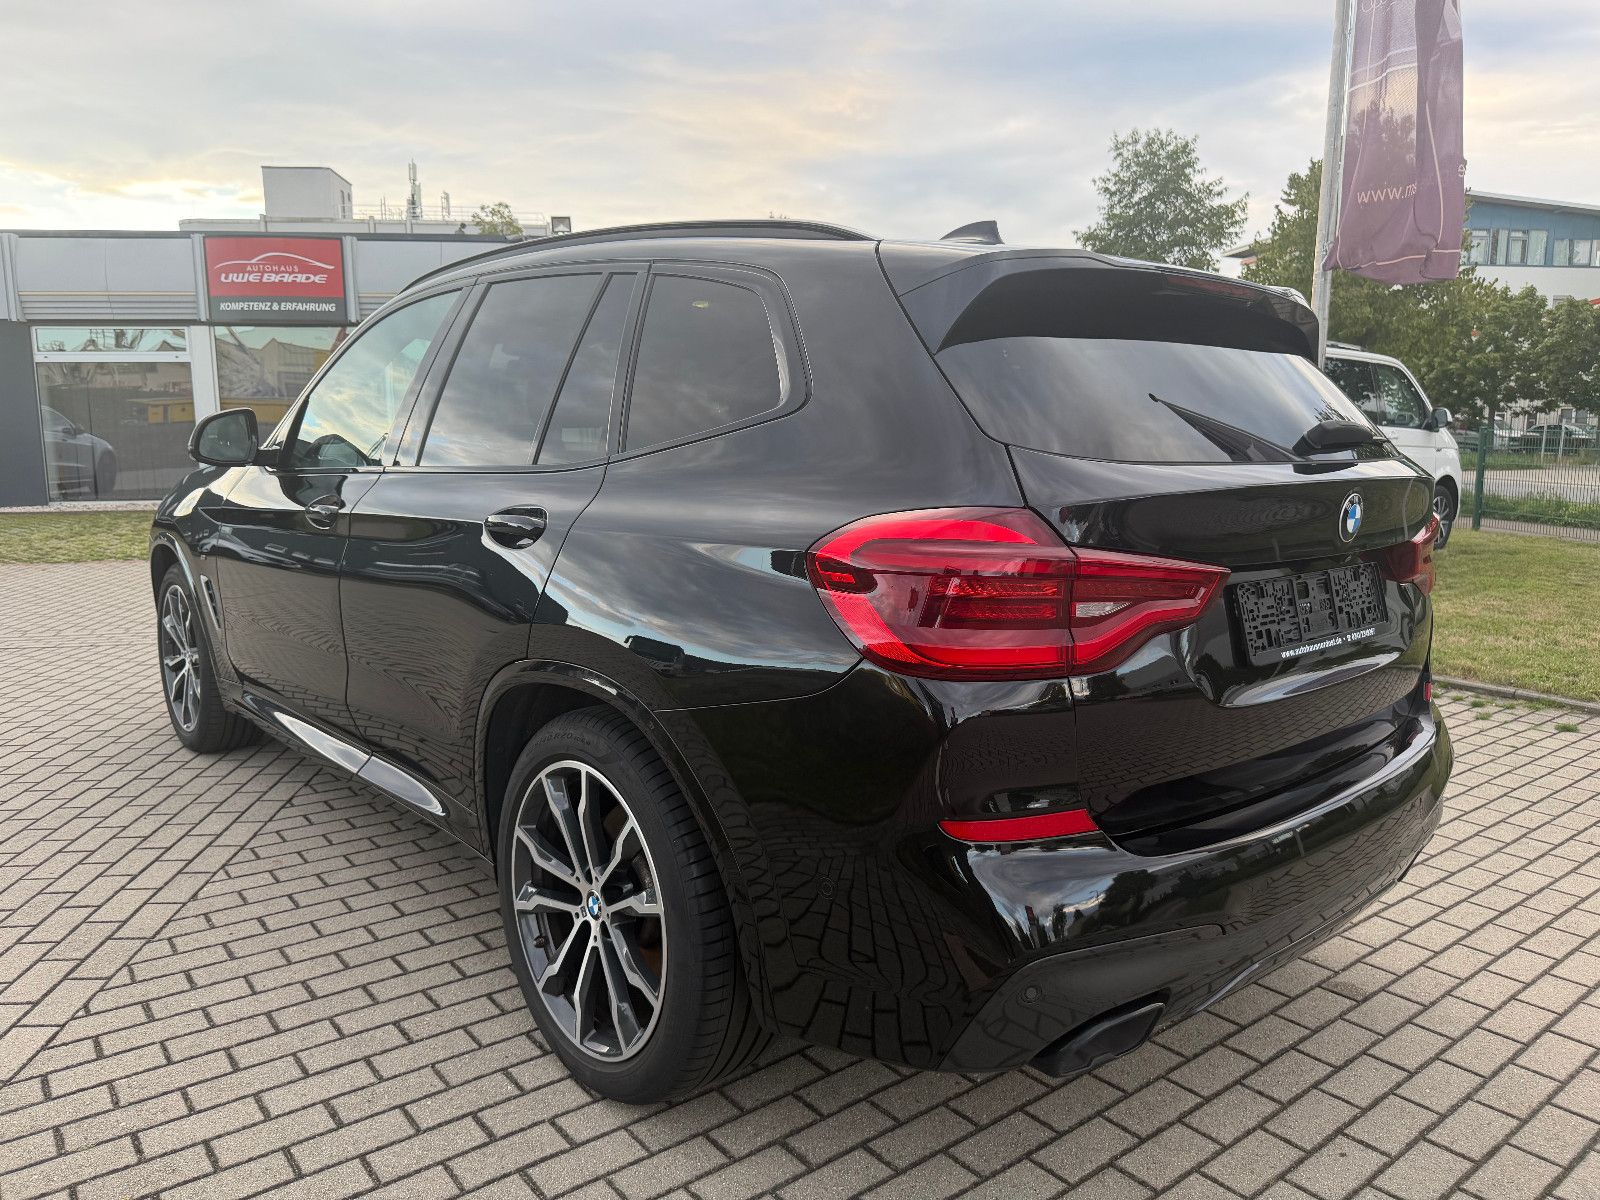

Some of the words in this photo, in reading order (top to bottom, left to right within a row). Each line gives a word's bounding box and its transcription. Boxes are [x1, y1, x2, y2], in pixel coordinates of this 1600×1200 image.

[246, 264, 299, 273] AUTOHAUS
[220, 272, 262, 283] UWE
[262, 273, 327, 284] BAADE
[220, 302, 271, 311] KOMPETENZ
[271, 303, 279, 311] &
[281, 302, 336, 312] ERFAHRUNG
